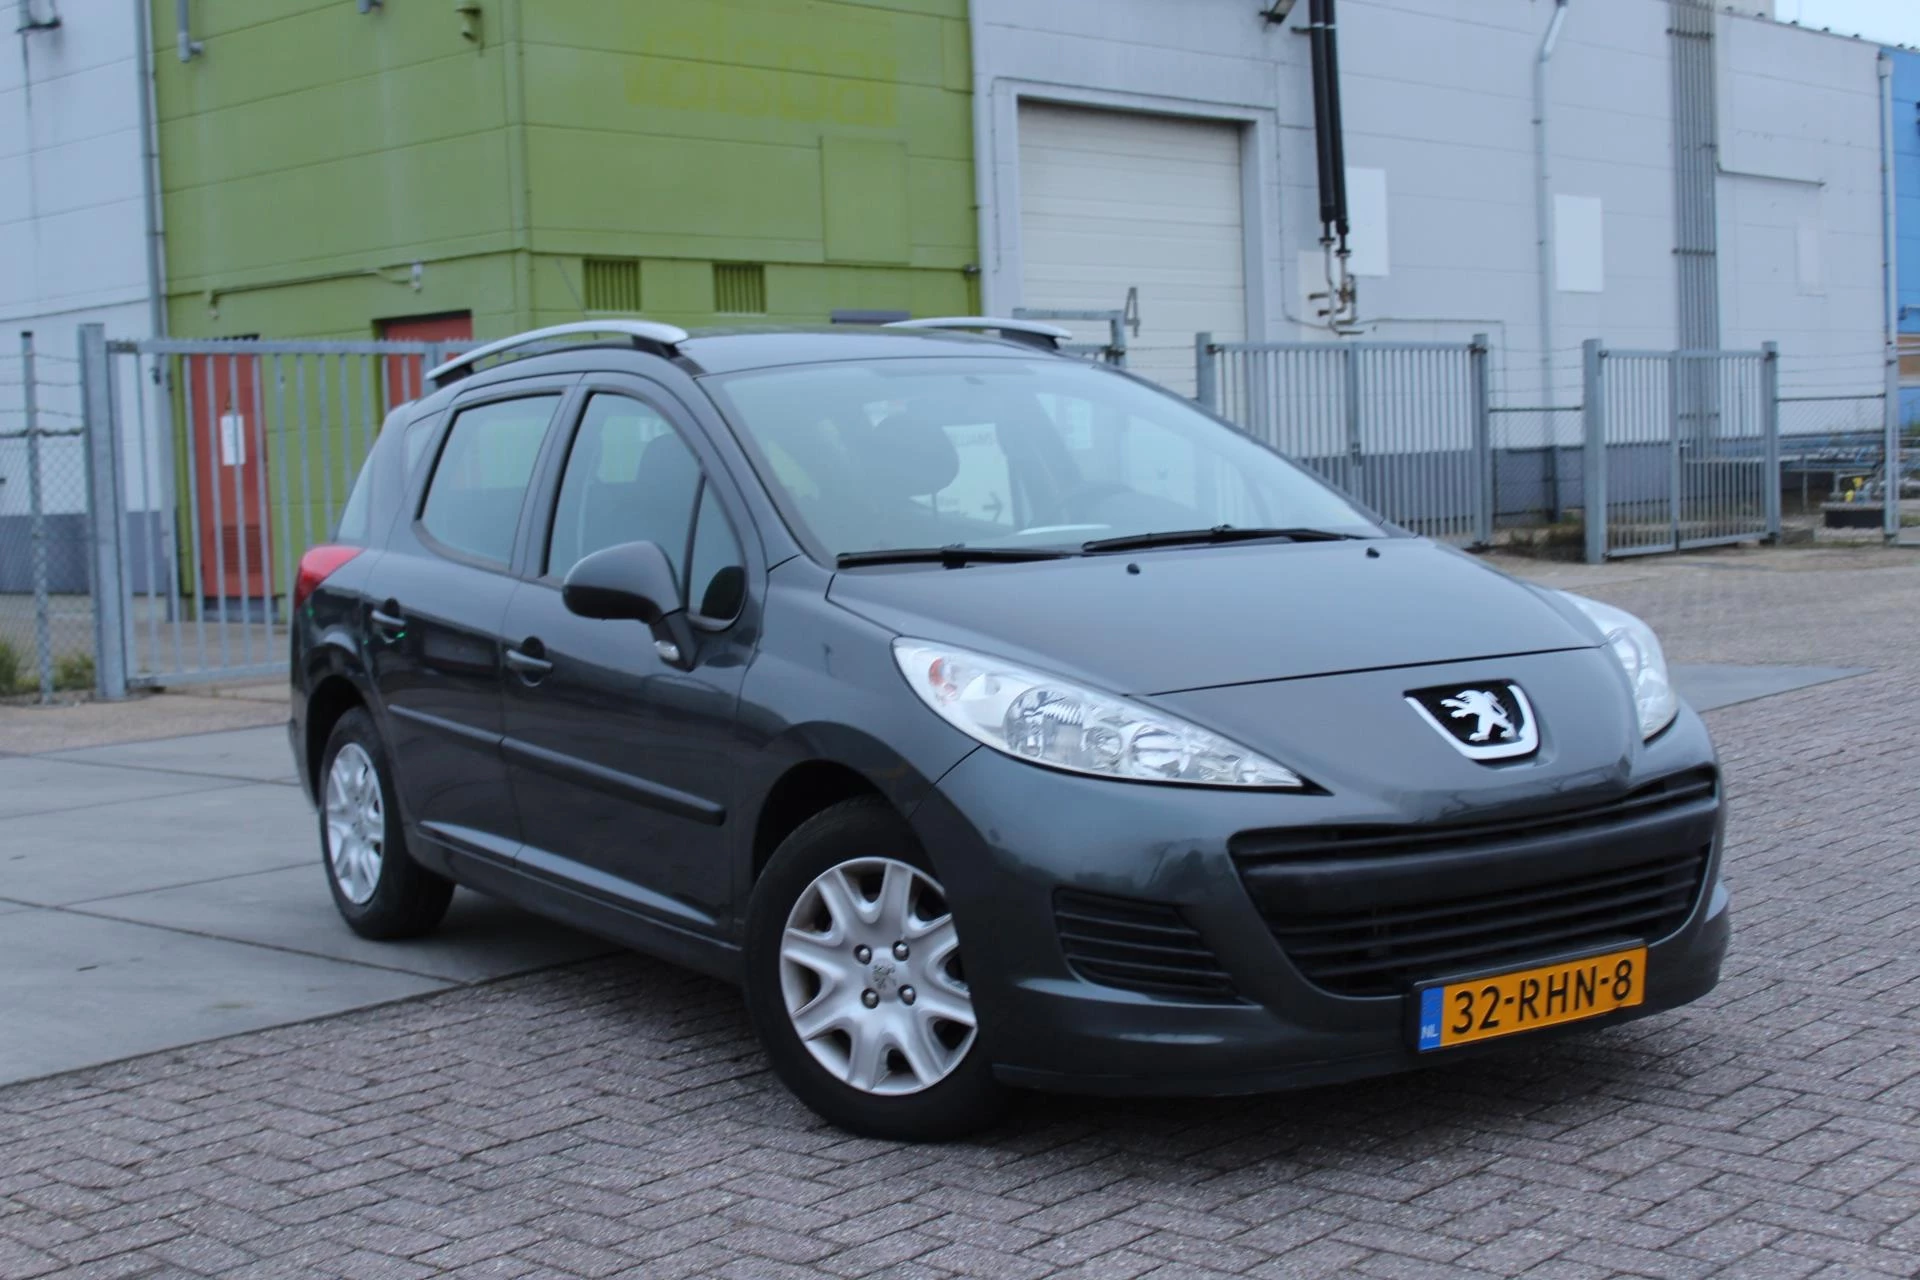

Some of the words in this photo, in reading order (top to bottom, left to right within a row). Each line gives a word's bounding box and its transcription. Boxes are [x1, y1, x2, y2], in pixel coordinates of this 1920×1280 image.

[1124, 286, 1141, 338] 4
[1452, 959, 1633, 1035] 32-RHN-8
[1420, 1023, 1440, 1039] NL
